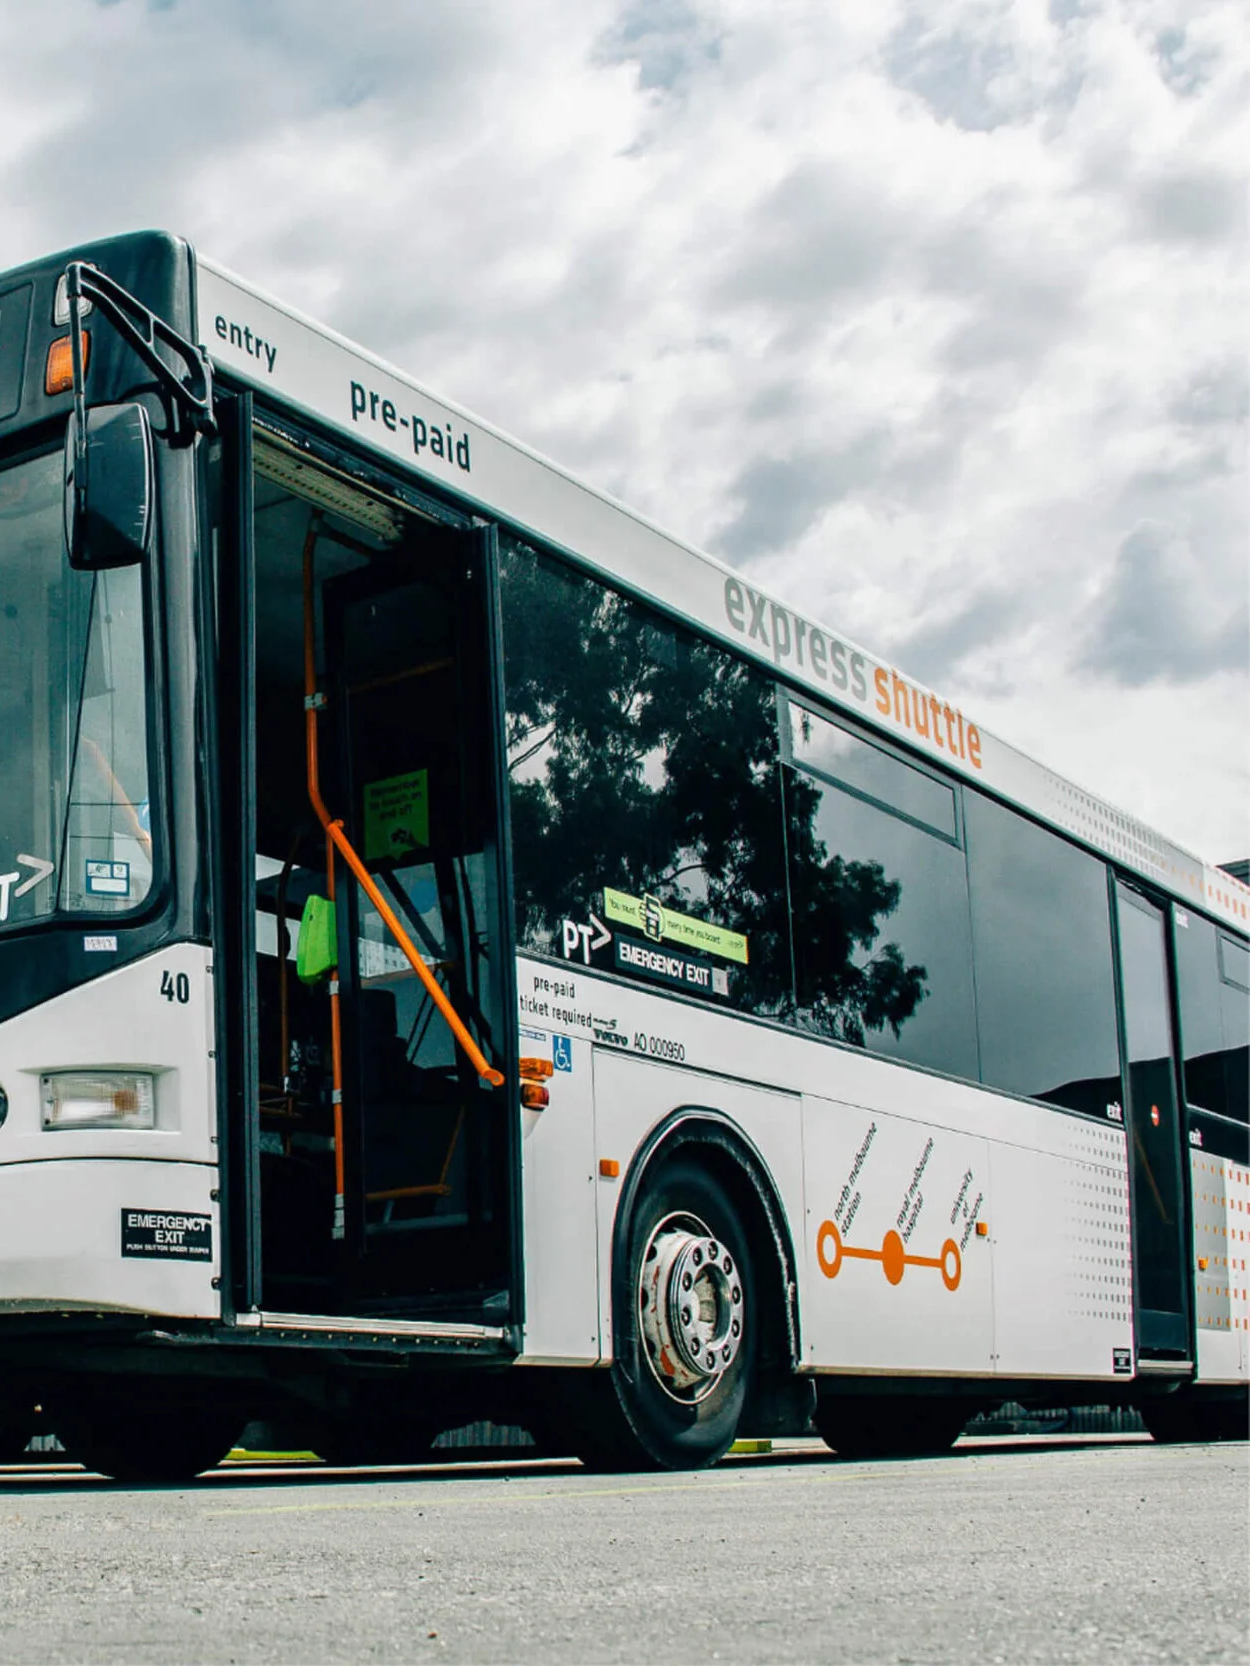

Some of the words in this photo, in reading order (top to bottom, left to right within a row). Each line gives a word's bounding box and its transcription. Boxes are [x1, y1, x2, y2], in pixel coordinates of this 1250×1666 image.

[215, 314, 277, 373] entry
[350, 380, 471, 473] pre-paid
[724, 576, 868, 702] express
[874, 666, 983, 769] shuttle
[618, 942, 684, 979] EMERGENCY
[686, 964, 709, 986] EXIT
[160, 970, 189, 1004] 40
[533, 976, 575, 999] pre-paid
[520, 995, 549, 1017] ticket
[552, 1006, 592, 1028] required
[593, 1028, 628, 1046] VOLVO
[649, 1036, 685, 1061] 000950
[834, 1184, 850, 1221] north
[848, 1121, 877, 1187] melbourne
[897, 1193, 910, 1228] royal
[908, 1137, 934, 1199] melbourne
[128, 1213, 207, 1232] EMERGENCY
[841, 1191, 861, 1238] station
[902, 1191, 923, 1244] hospital
[155, 1230, 185, 1244] EXIT
